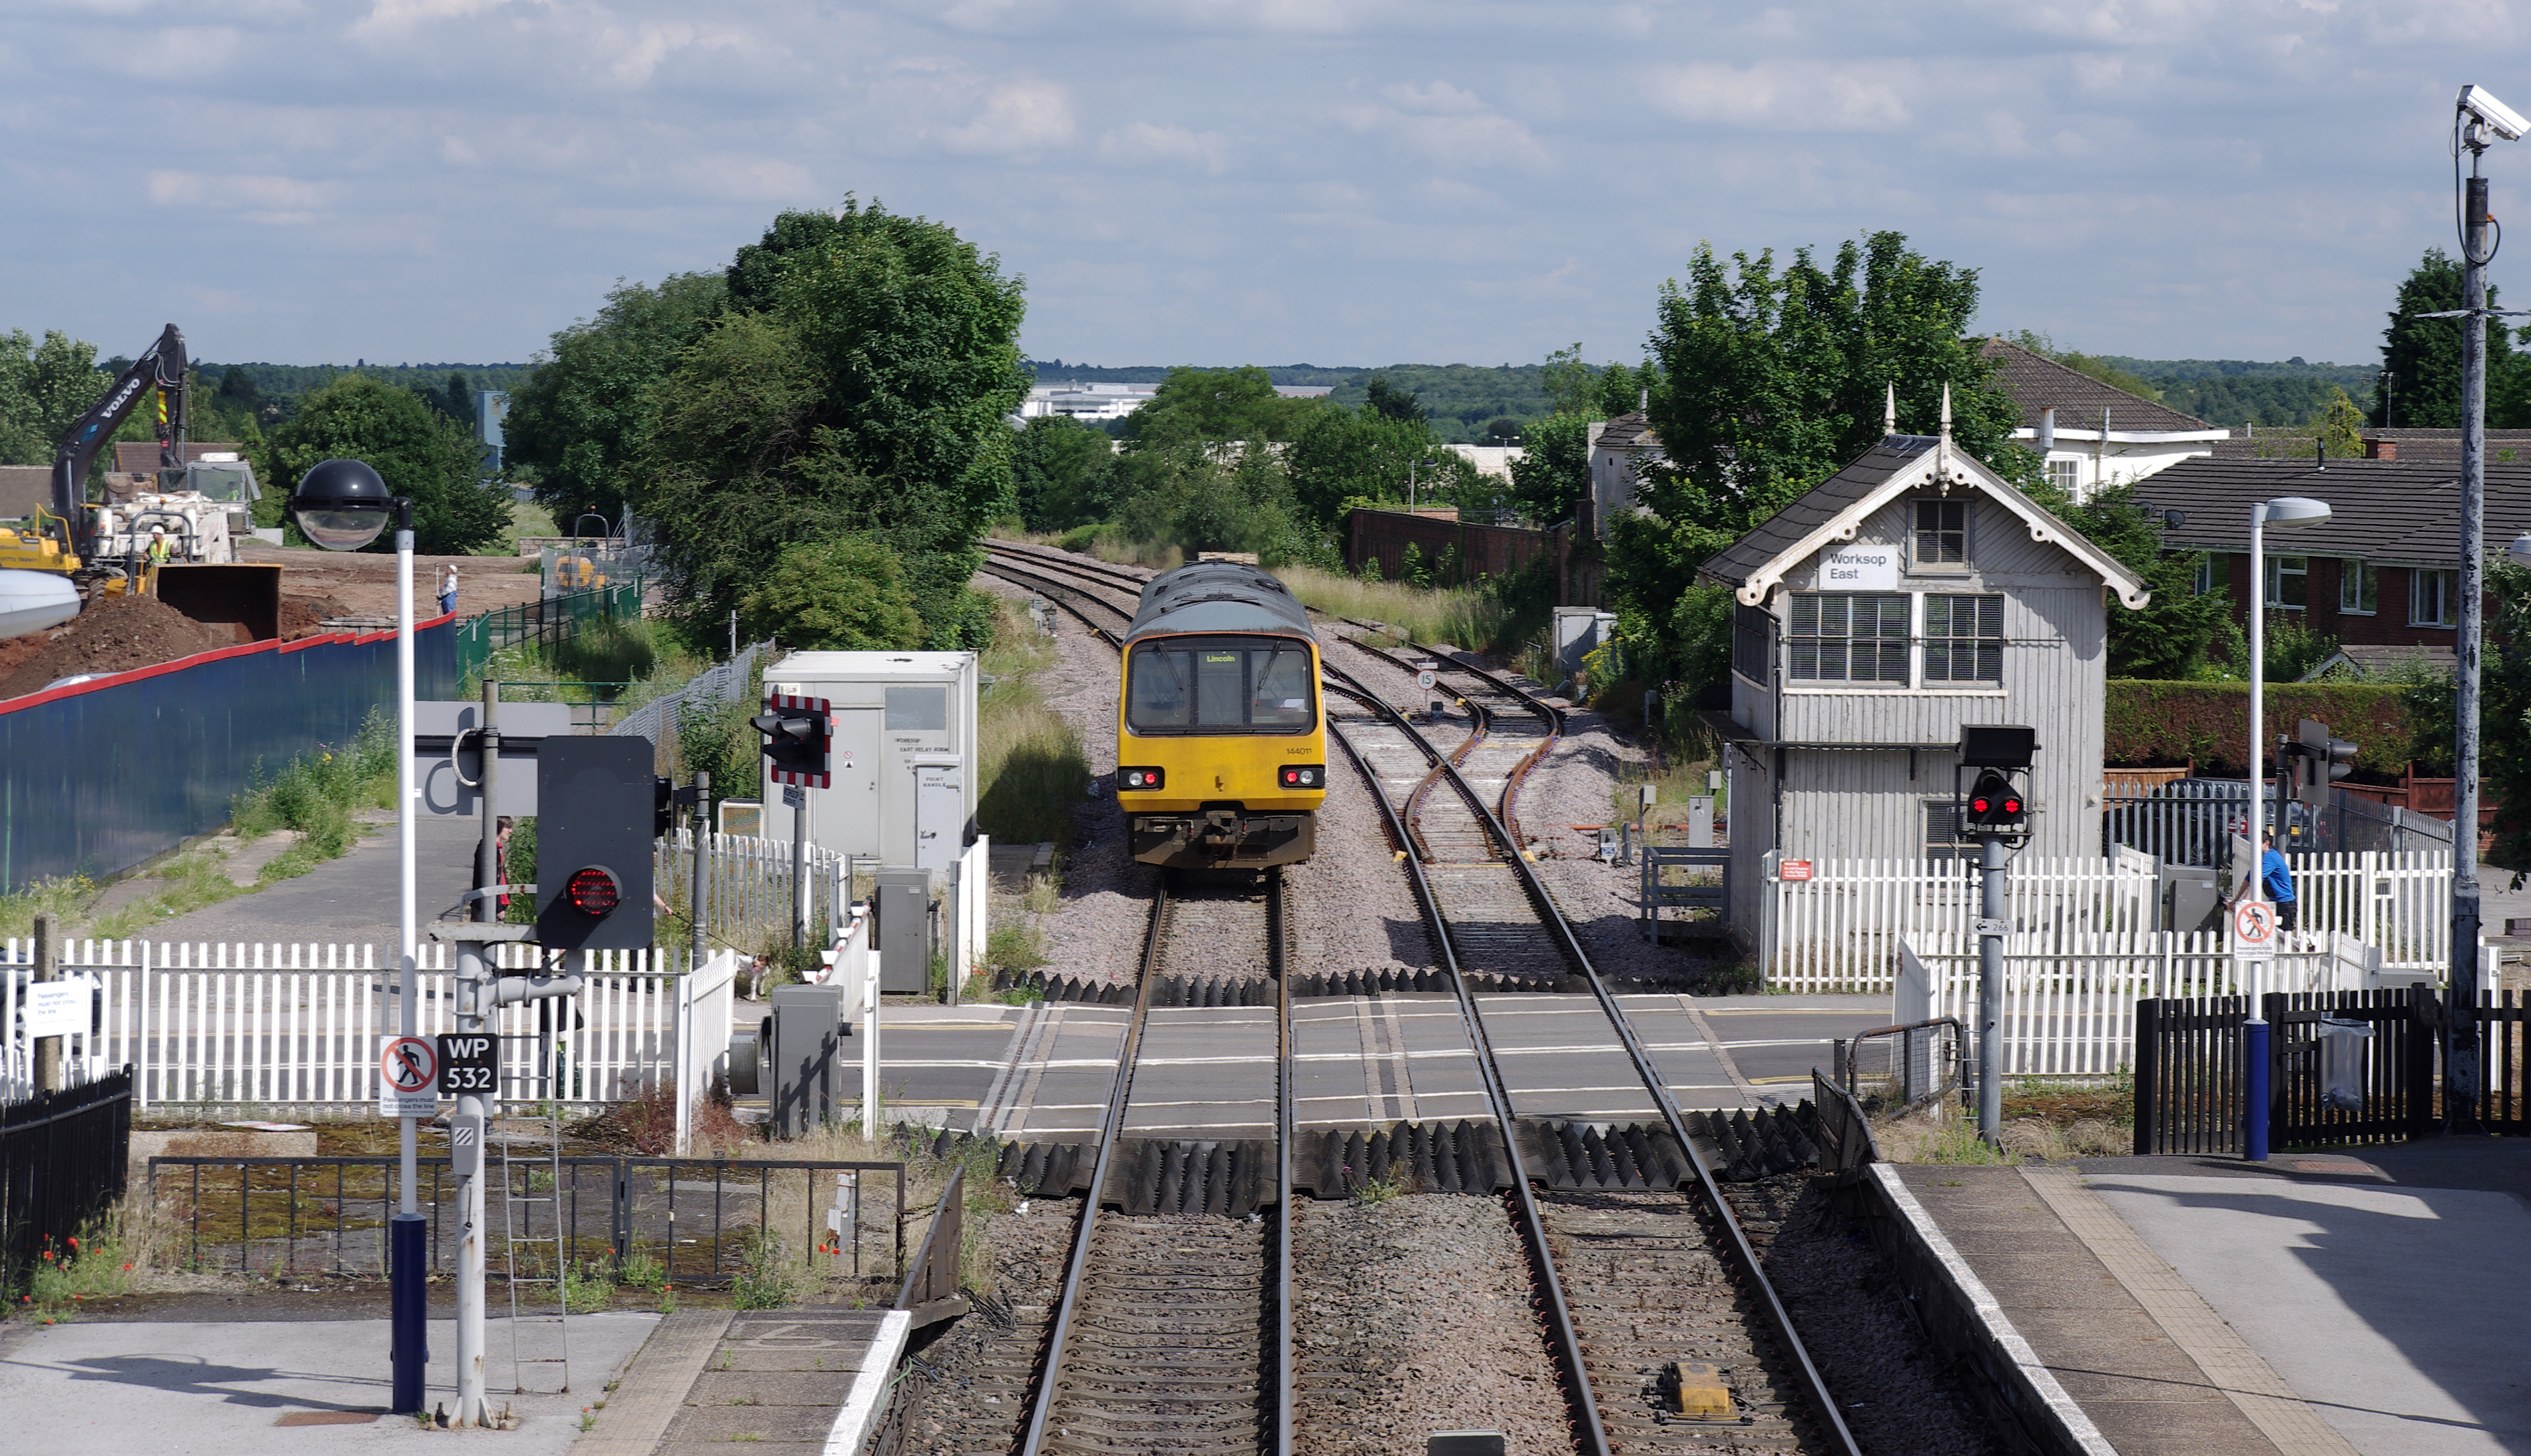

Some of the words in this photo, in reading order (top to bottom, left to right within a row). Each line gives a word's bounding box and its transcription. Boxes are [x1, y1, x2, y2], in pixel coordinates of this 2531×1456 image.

[101, 378, 141, 419] VOLVO
[1830, 553, 1886, 567] Worksop
[1830, 568, 1859, 579] East
[1422, 674, 1432, 684] 15
[447, 1038, 489, 1059] WP
[446, 1067, 491, 1089] 532
